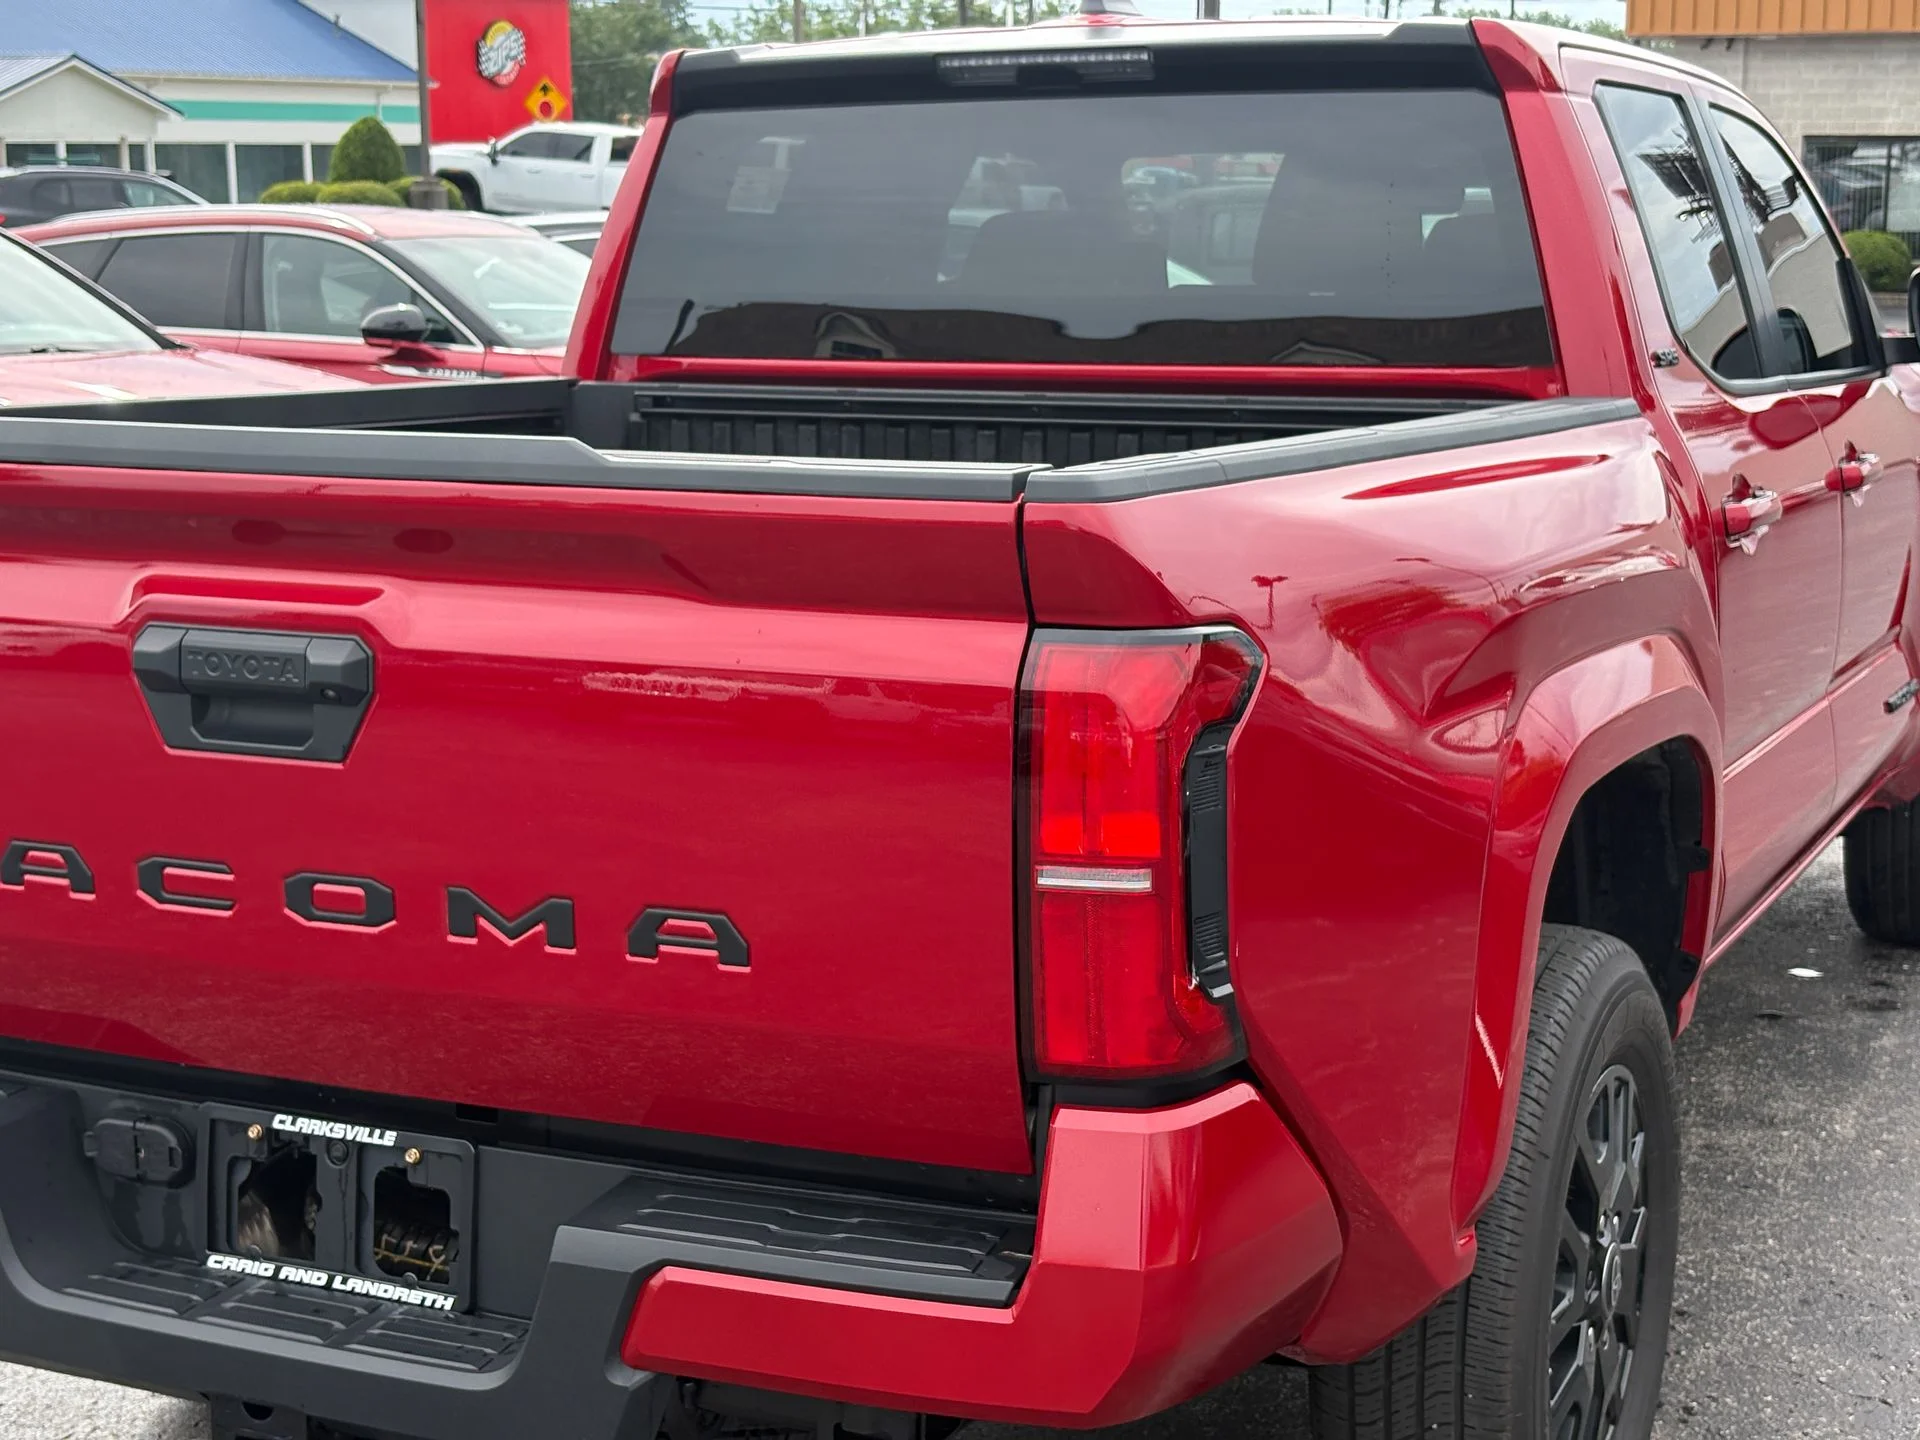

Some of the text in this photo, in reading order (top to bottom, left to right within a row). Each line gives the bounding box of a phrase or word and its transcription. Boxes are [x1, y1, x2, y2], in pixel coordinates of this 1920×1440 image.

[187, 651, 300, 682] TOYOTA
[272, 1114, 397, 1147] CLARKSVILLE
[206, 1254, 456, 1311] CRAIG AND LANDRETH
